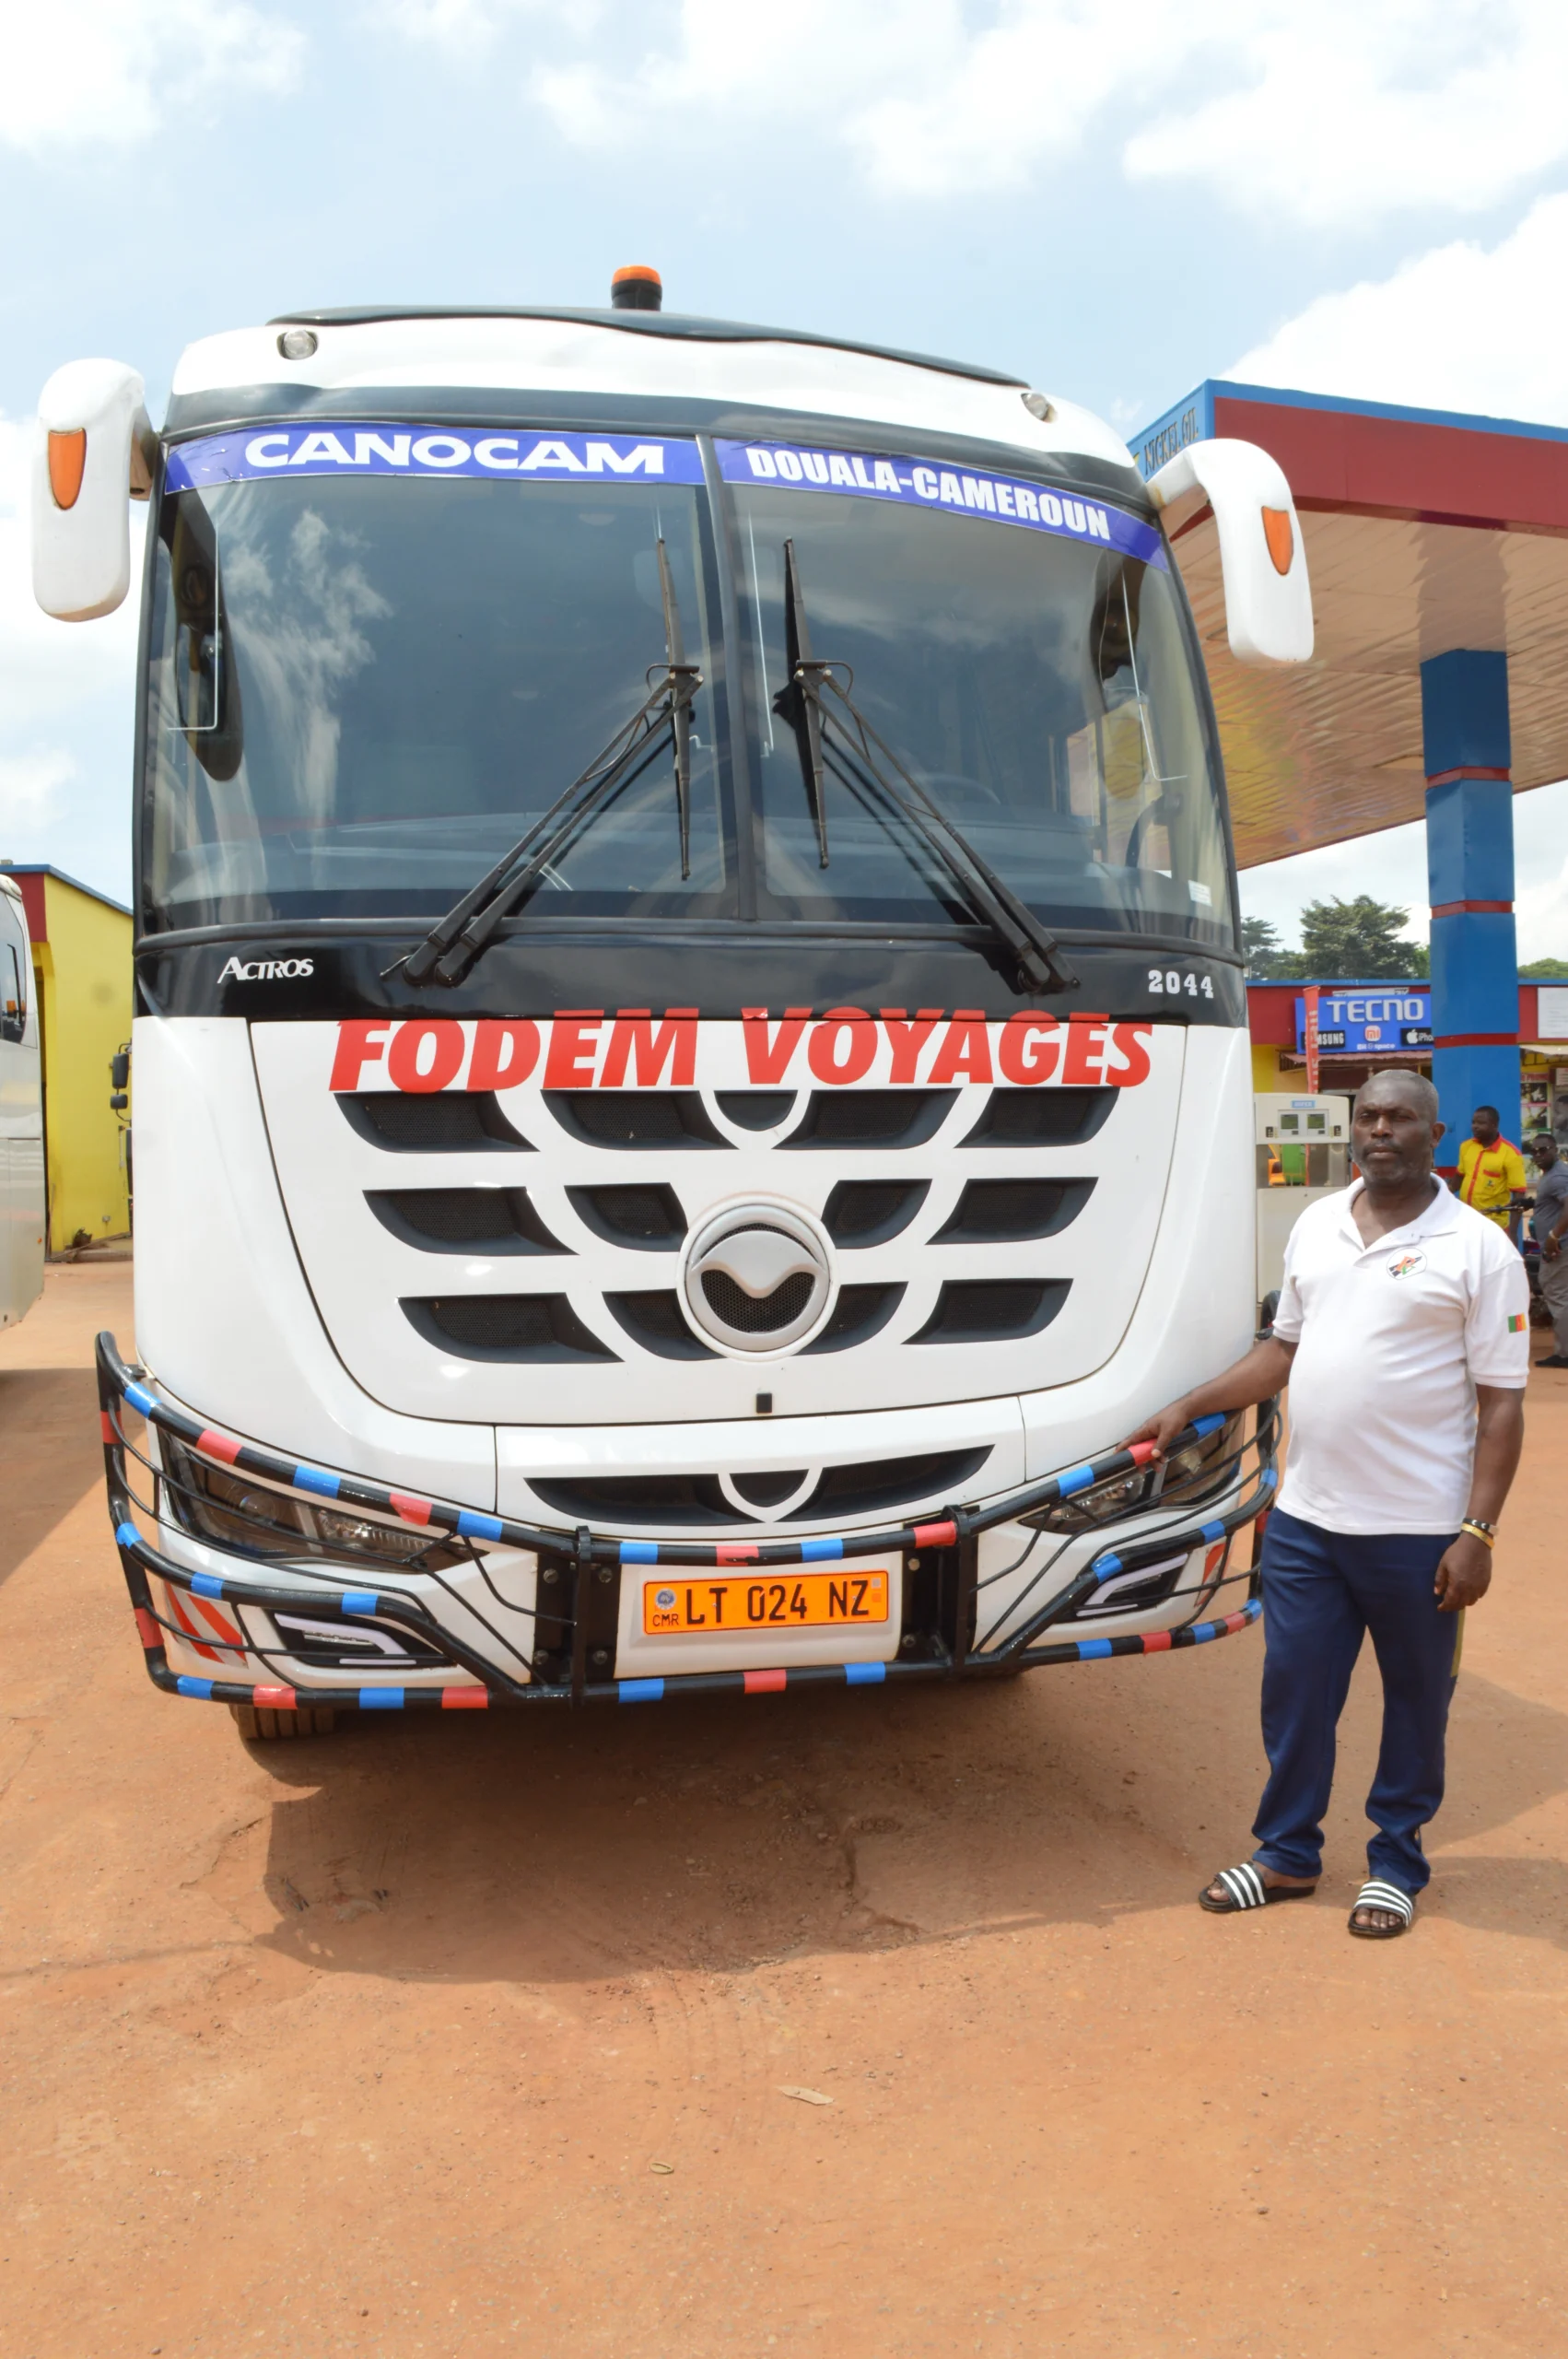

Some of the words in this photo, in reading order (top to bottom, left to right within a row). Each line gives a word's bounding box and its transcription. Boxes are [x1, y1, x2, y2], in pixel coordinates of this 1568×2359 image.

[245, 432, 665, 475] CANOCAM
[1144, 420, 1181, 475] NICKEL
[1182, 406, 1199, 446] OIL
[745, 448, 1111, 541] DOUALA-CAMEROUN
[1148, 969, 1213, 999] 2044
[1326, 998, 1424, 1023] TECNO
[328, 1007, 700, 1094] FODEM
[741, 1006, 1153, 1088] VOYAGES
[1305, 1032, 1345, 1045] MSUNG
[652, 1613, 680, 1627] CMR
[685, 1586, 728, 1625] LT
[747, 1583, 807, 1622] 024
[828, 1579, 870, 1618] NZ
